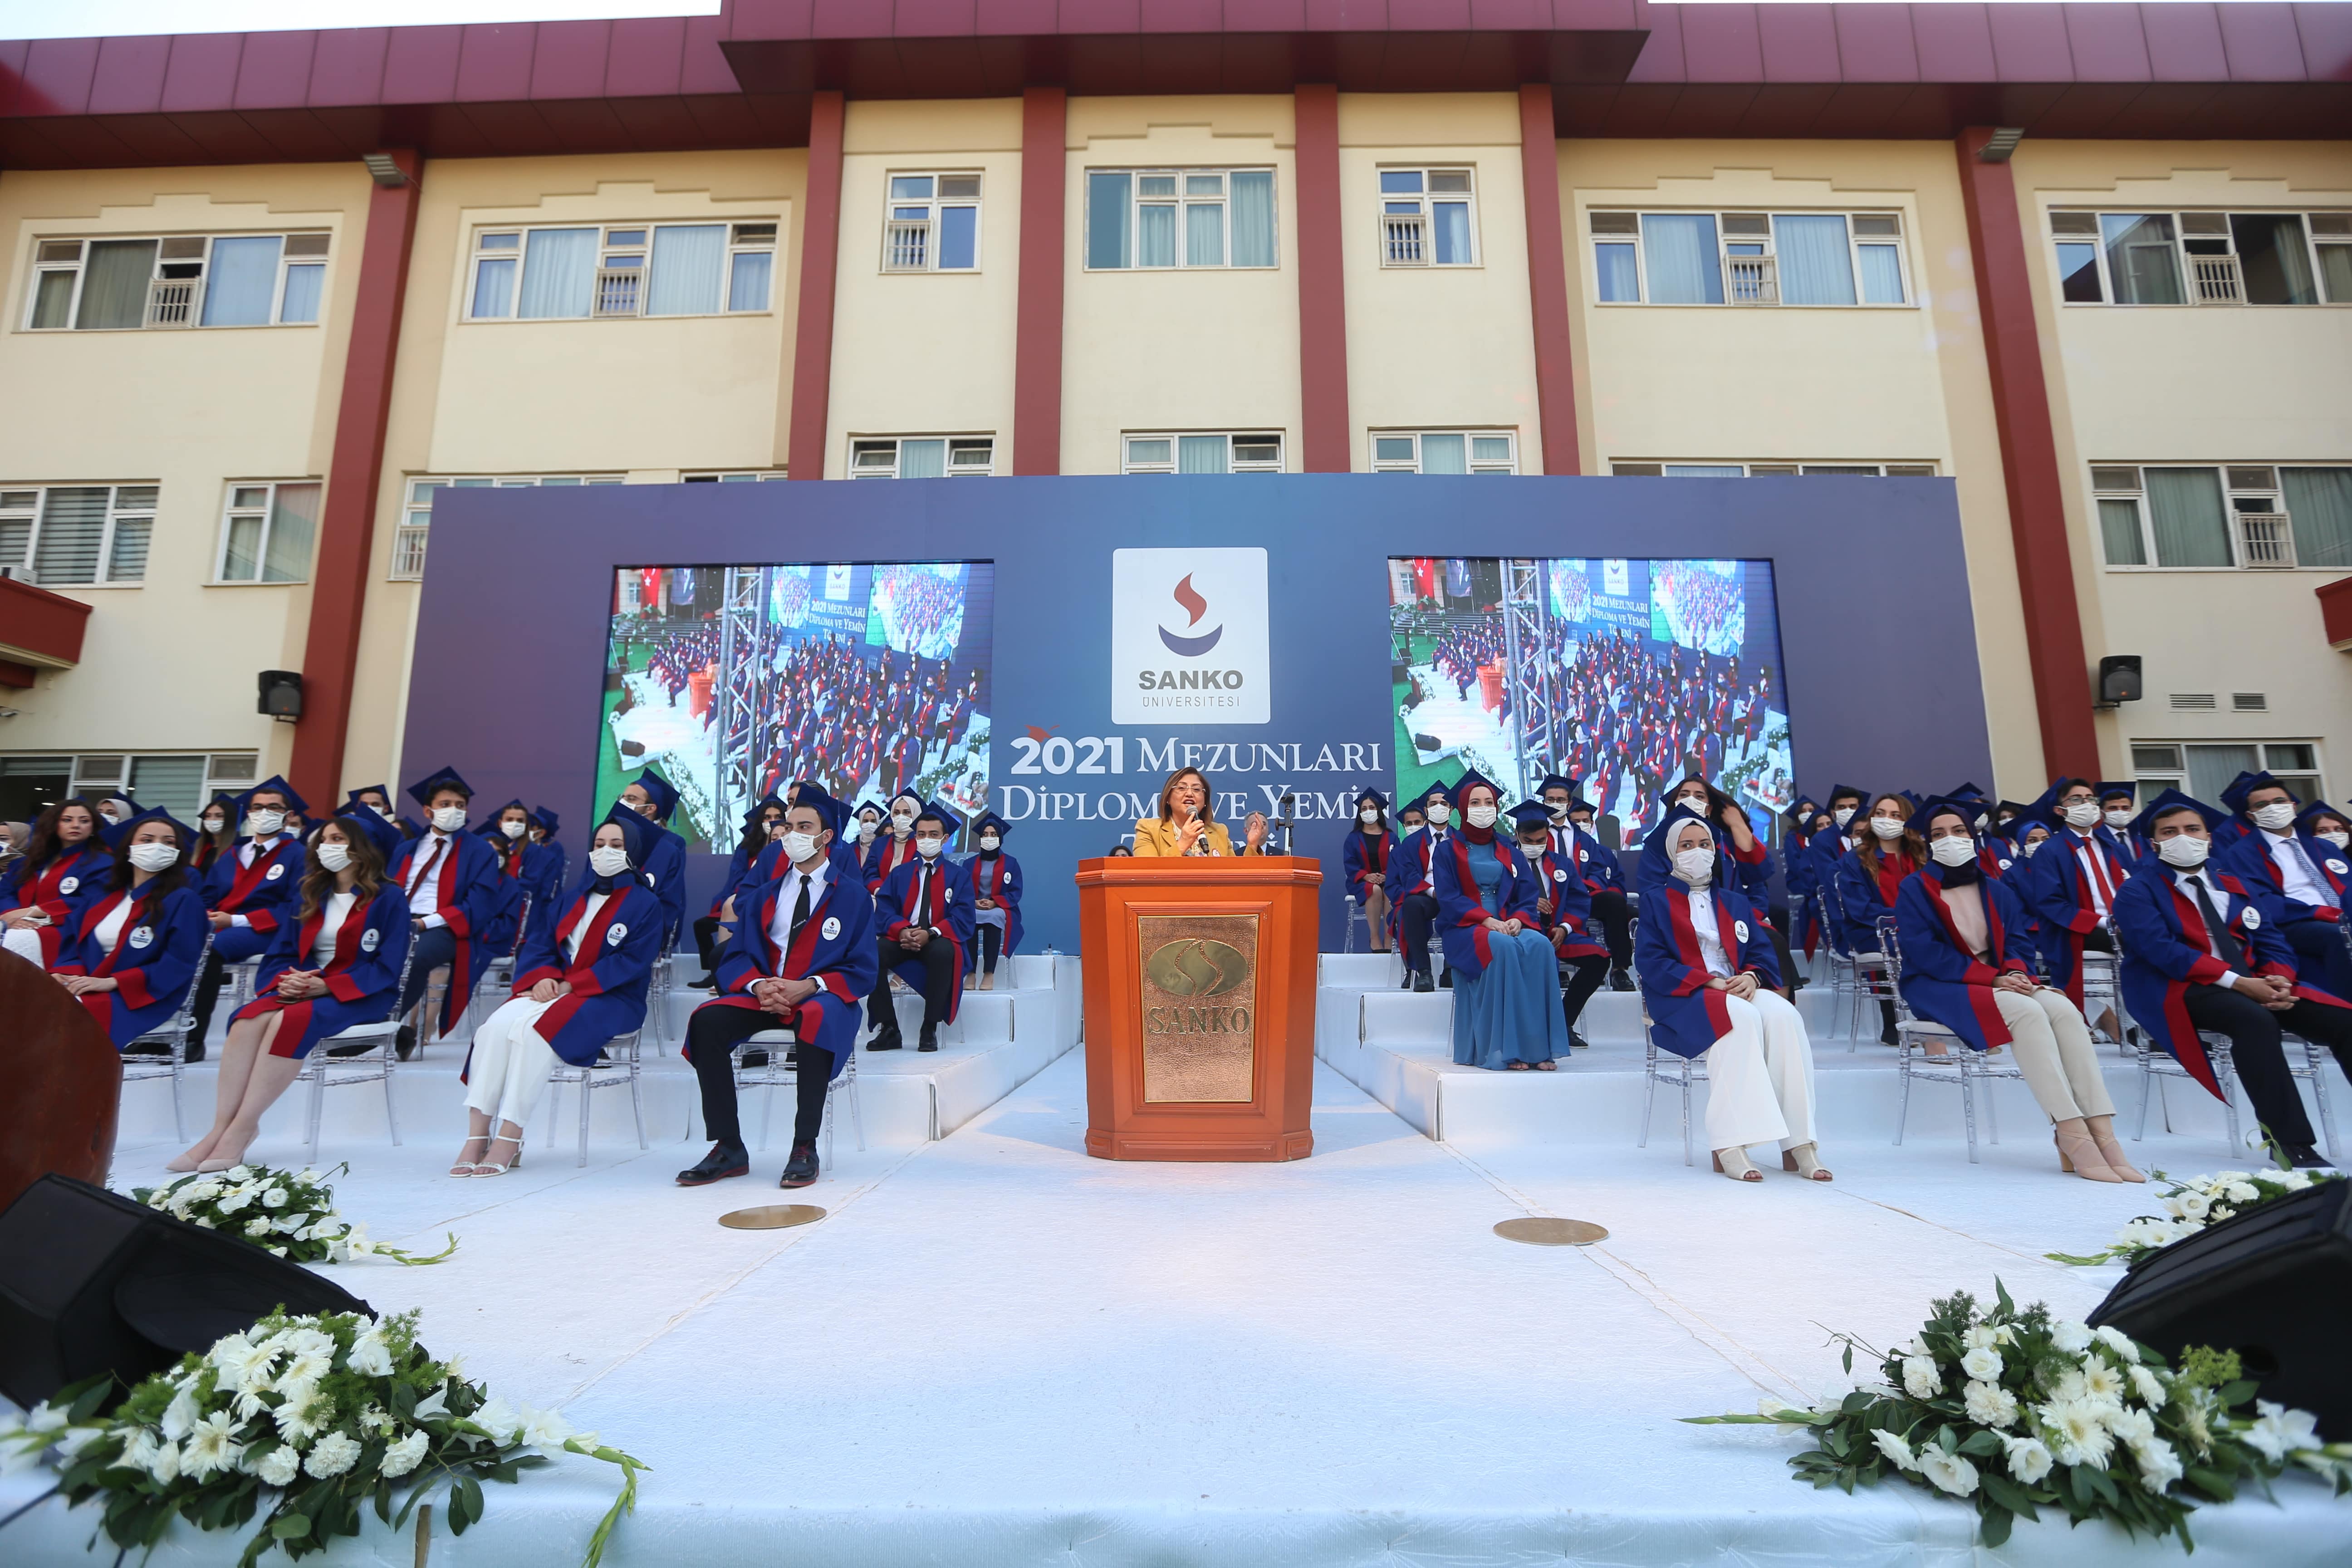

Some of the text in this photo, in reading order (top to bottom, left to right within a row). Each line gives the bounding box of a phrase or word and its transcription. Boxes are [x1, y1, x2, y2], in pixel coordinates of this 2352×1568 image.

[811, 600, 866, 618] 2021 MEZUNLARI
[1592, 595, 1648, 614] 2021 MEZUNLARI
[809, 613, 866, 633] DİPLOMA VE YEMİN
[1592, 608, 1651, 629] DİPLOMA VE YEMİN
[1138, 670, 1244, 690] SANKO
[1010, 736, 1383, 774] 2021 MEZUNLARI
[999, 785, 1161, 820] DİPLOM
[1149, 1006, 1250, 1034] SANKO
